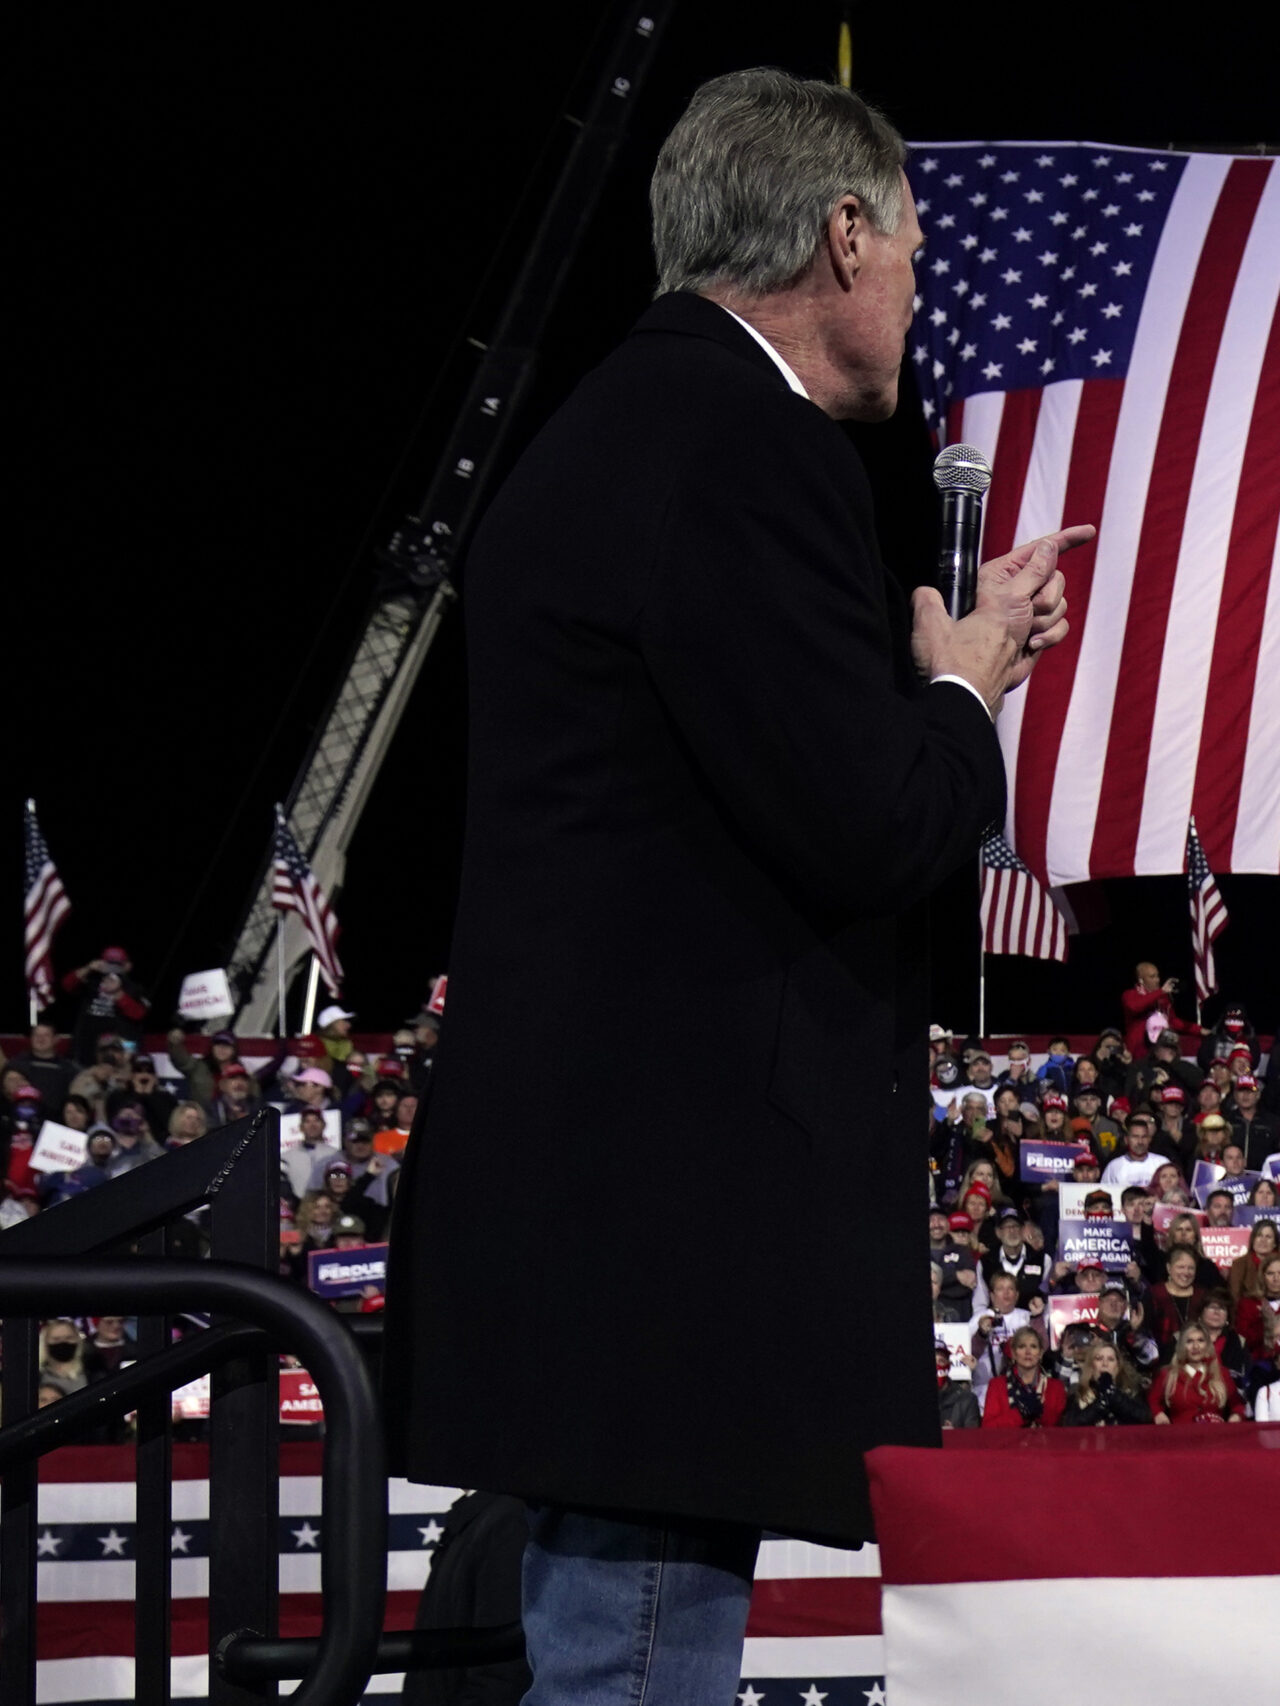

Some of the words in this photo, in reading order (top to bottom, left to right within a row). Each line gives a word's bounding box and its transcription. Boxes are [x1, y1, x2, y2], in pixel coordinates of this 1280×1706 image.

[1026, 1155, 1076, 1169] PERDU
[1083, 1227, 1113, 1237] MAKE
[1064, 1238, 1131, 1252] AMERICA
[1201, 1235, 1231, 1244] MAKE
[1204, 1245, 1248, 1257] ERICA
[1100, 1252, 1132, 1263] AGAIN
[1072, 1307, 1099, 1320] SAV
